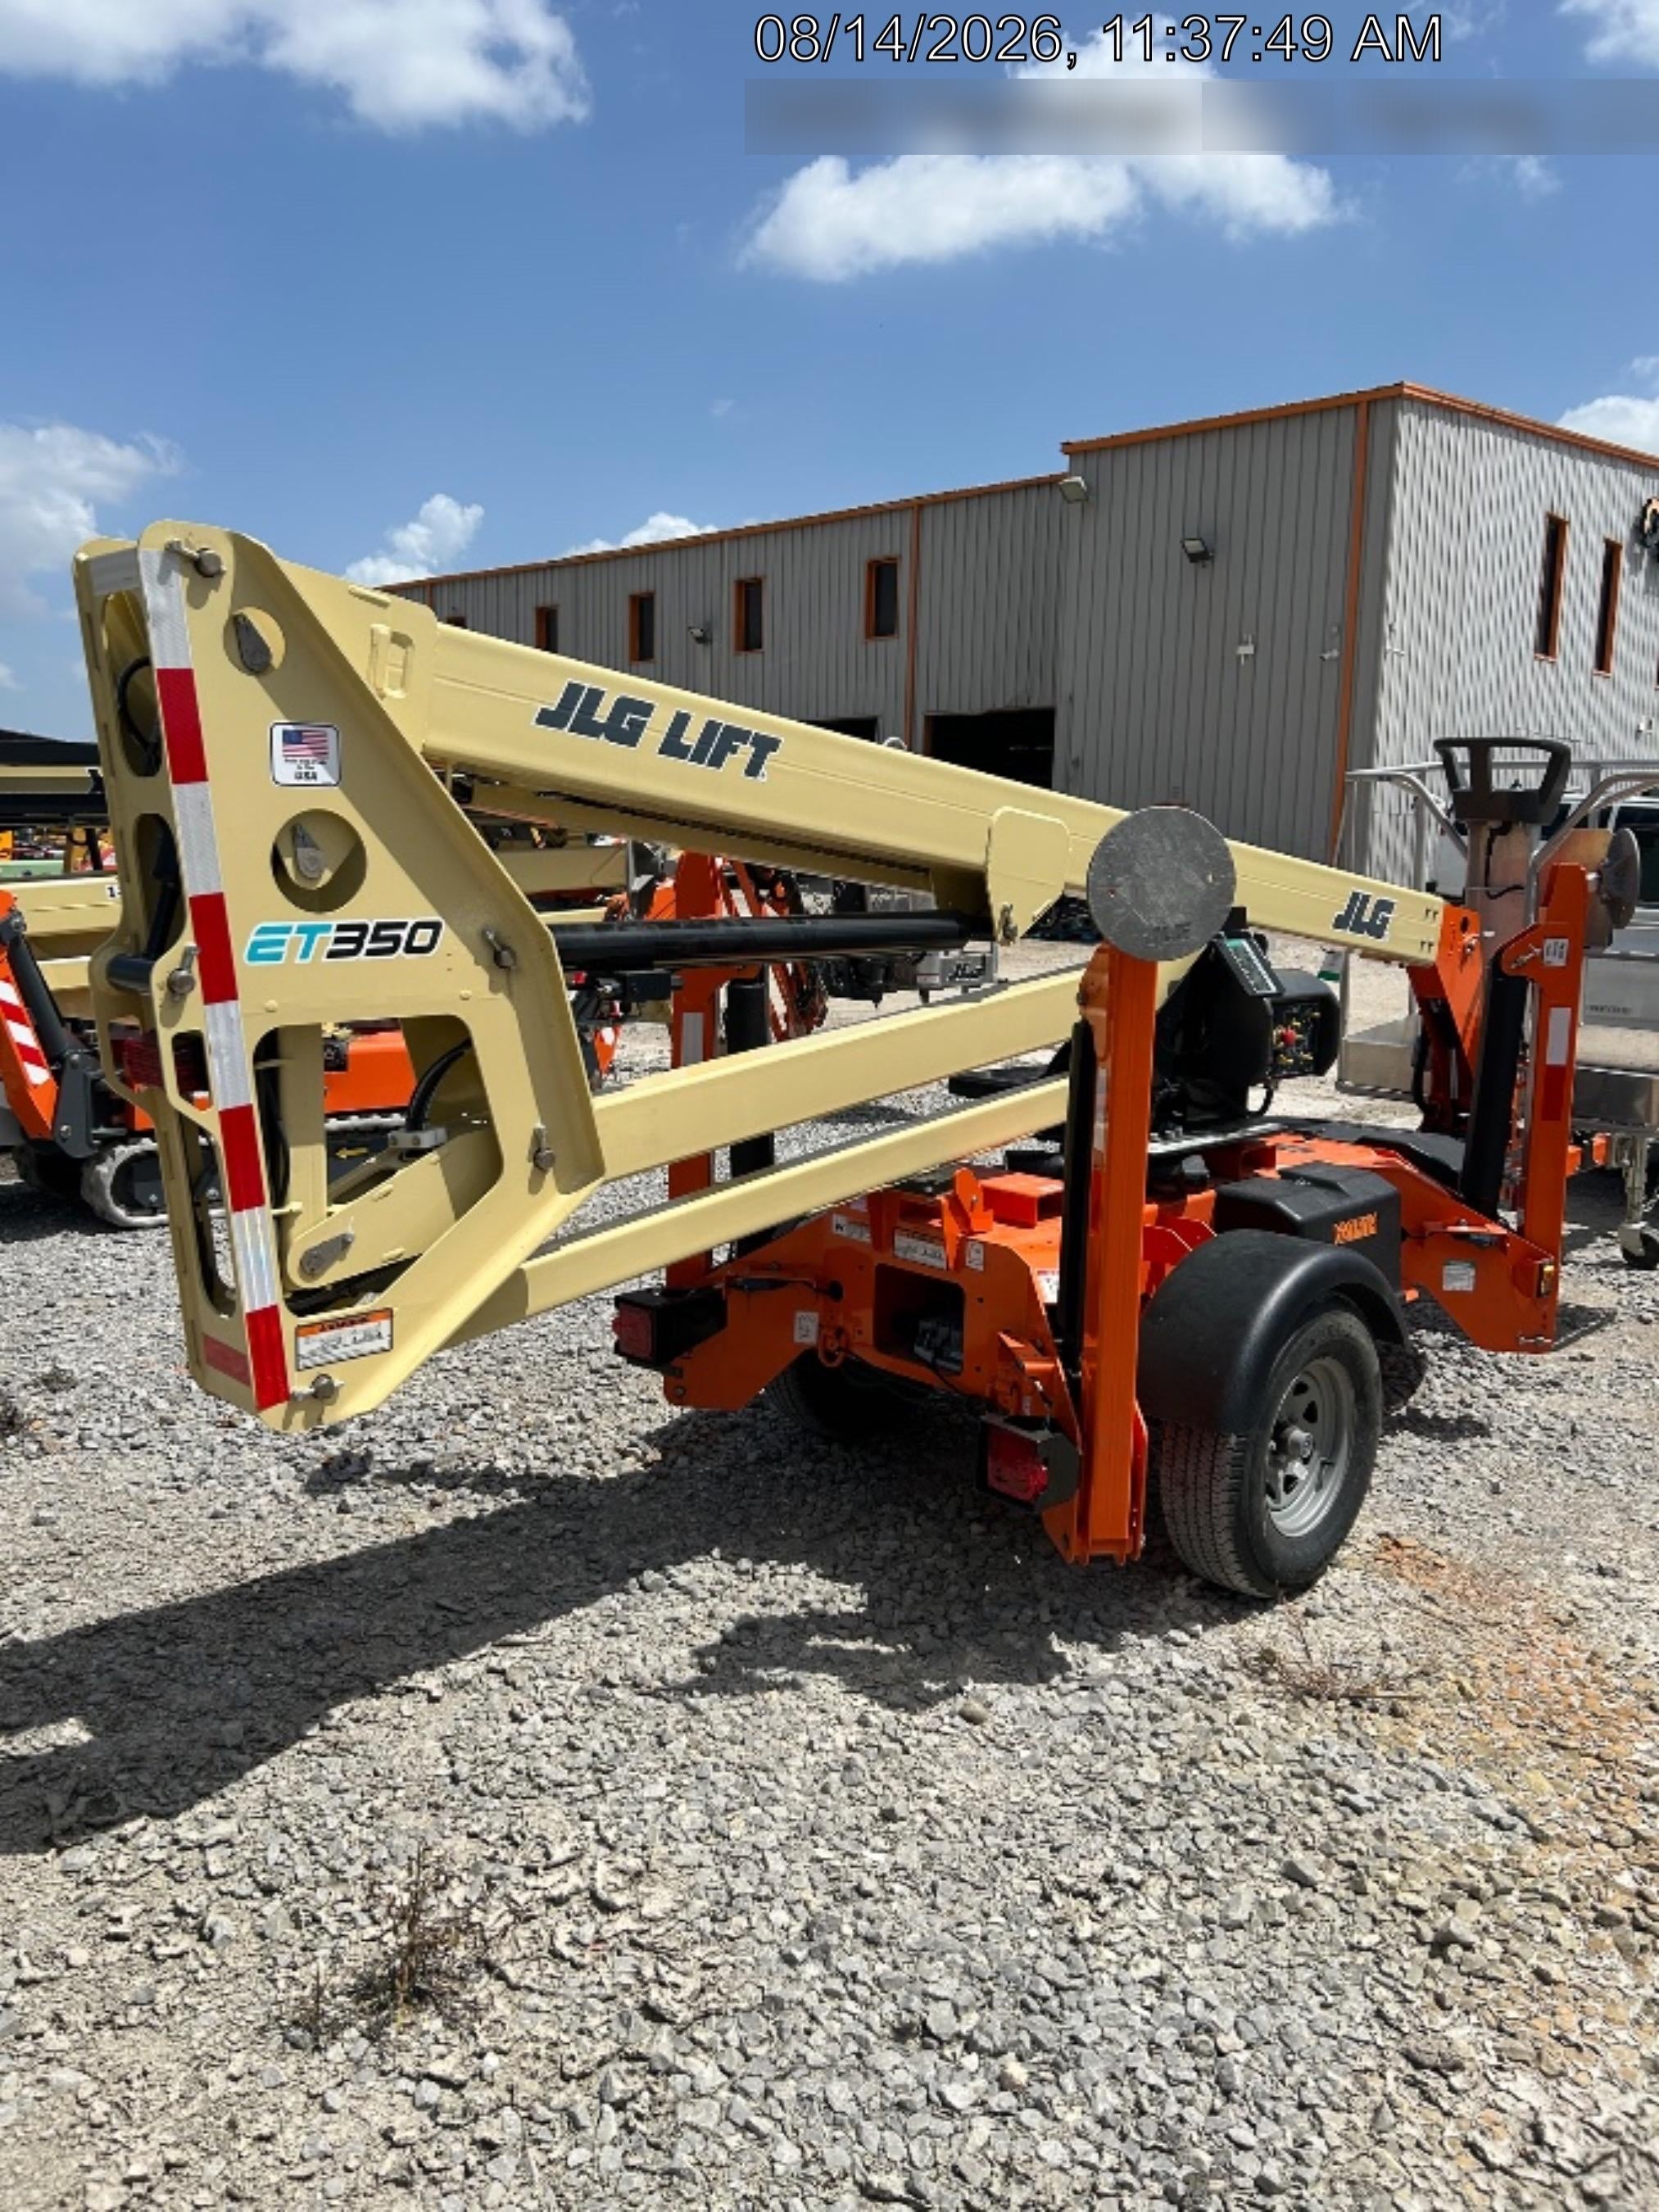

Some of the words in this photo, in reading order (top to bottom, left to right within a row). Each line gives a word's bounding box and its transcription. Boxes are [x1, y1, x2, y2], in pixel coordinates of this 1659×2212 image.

[534, 680, 656, 748] JLG
[657, 709, 782, 778] LIFT
[246, 918, 444, 964] ET350
[1332, 891, 1397, 941] JLG
